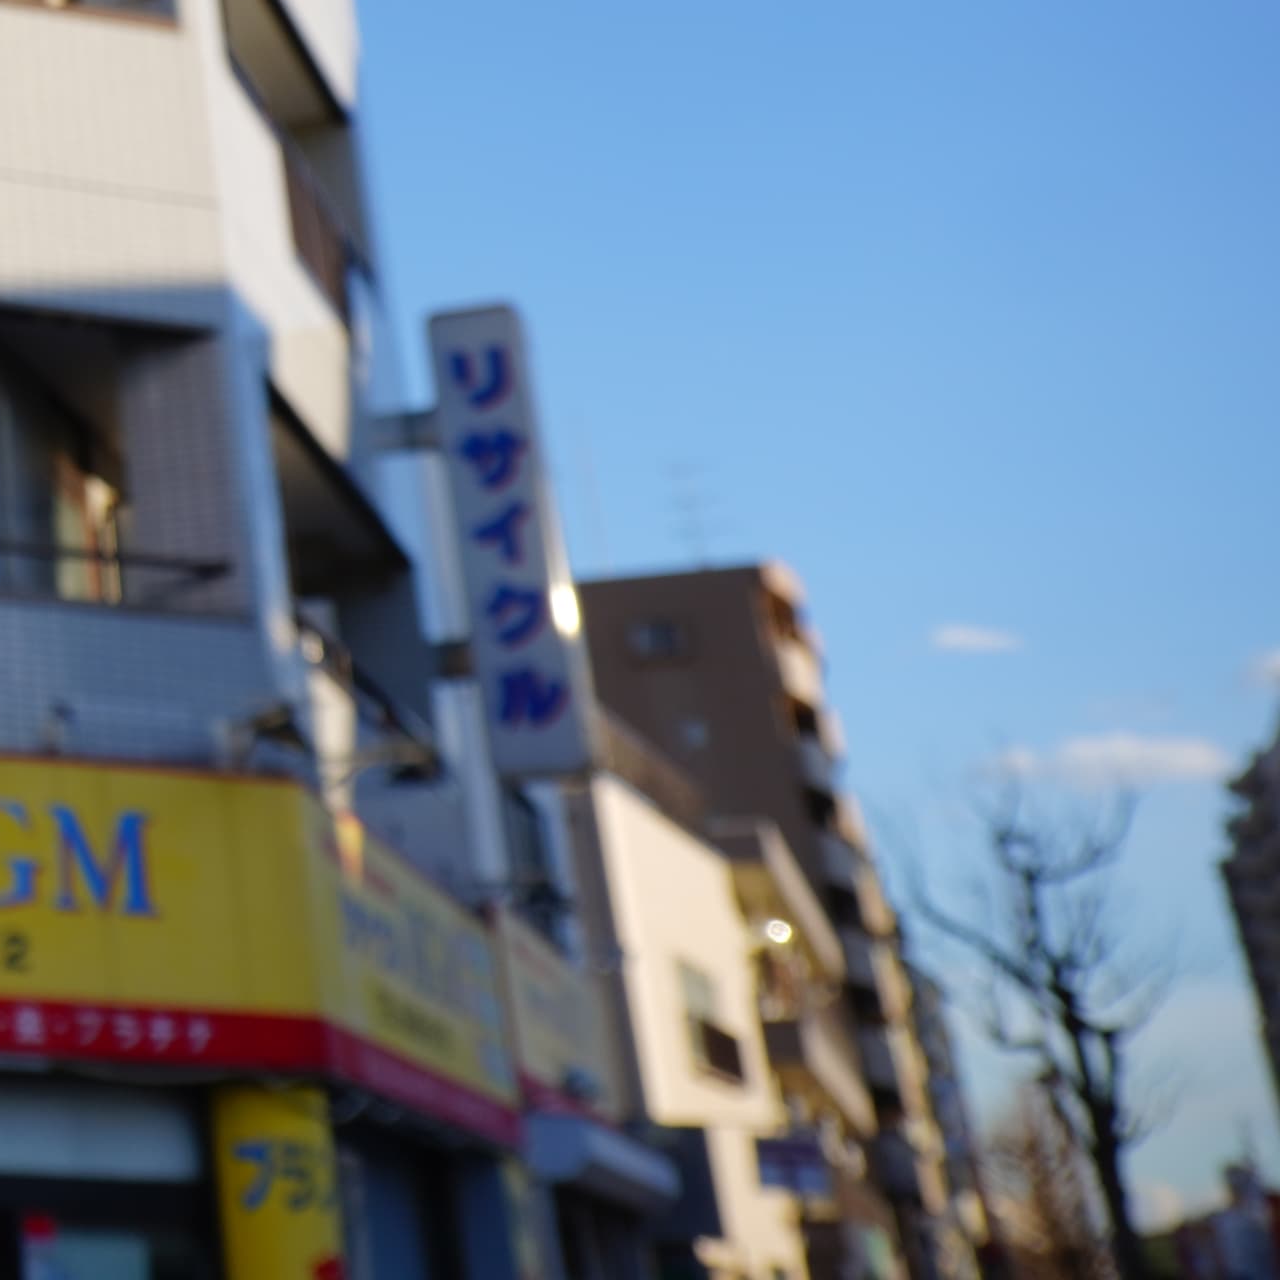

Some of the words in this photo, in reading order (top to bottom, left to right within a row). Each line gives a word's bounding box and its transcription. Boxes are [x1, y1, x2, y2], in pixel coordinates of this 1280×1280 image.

[449, 344, 570, 730] リサイクル
